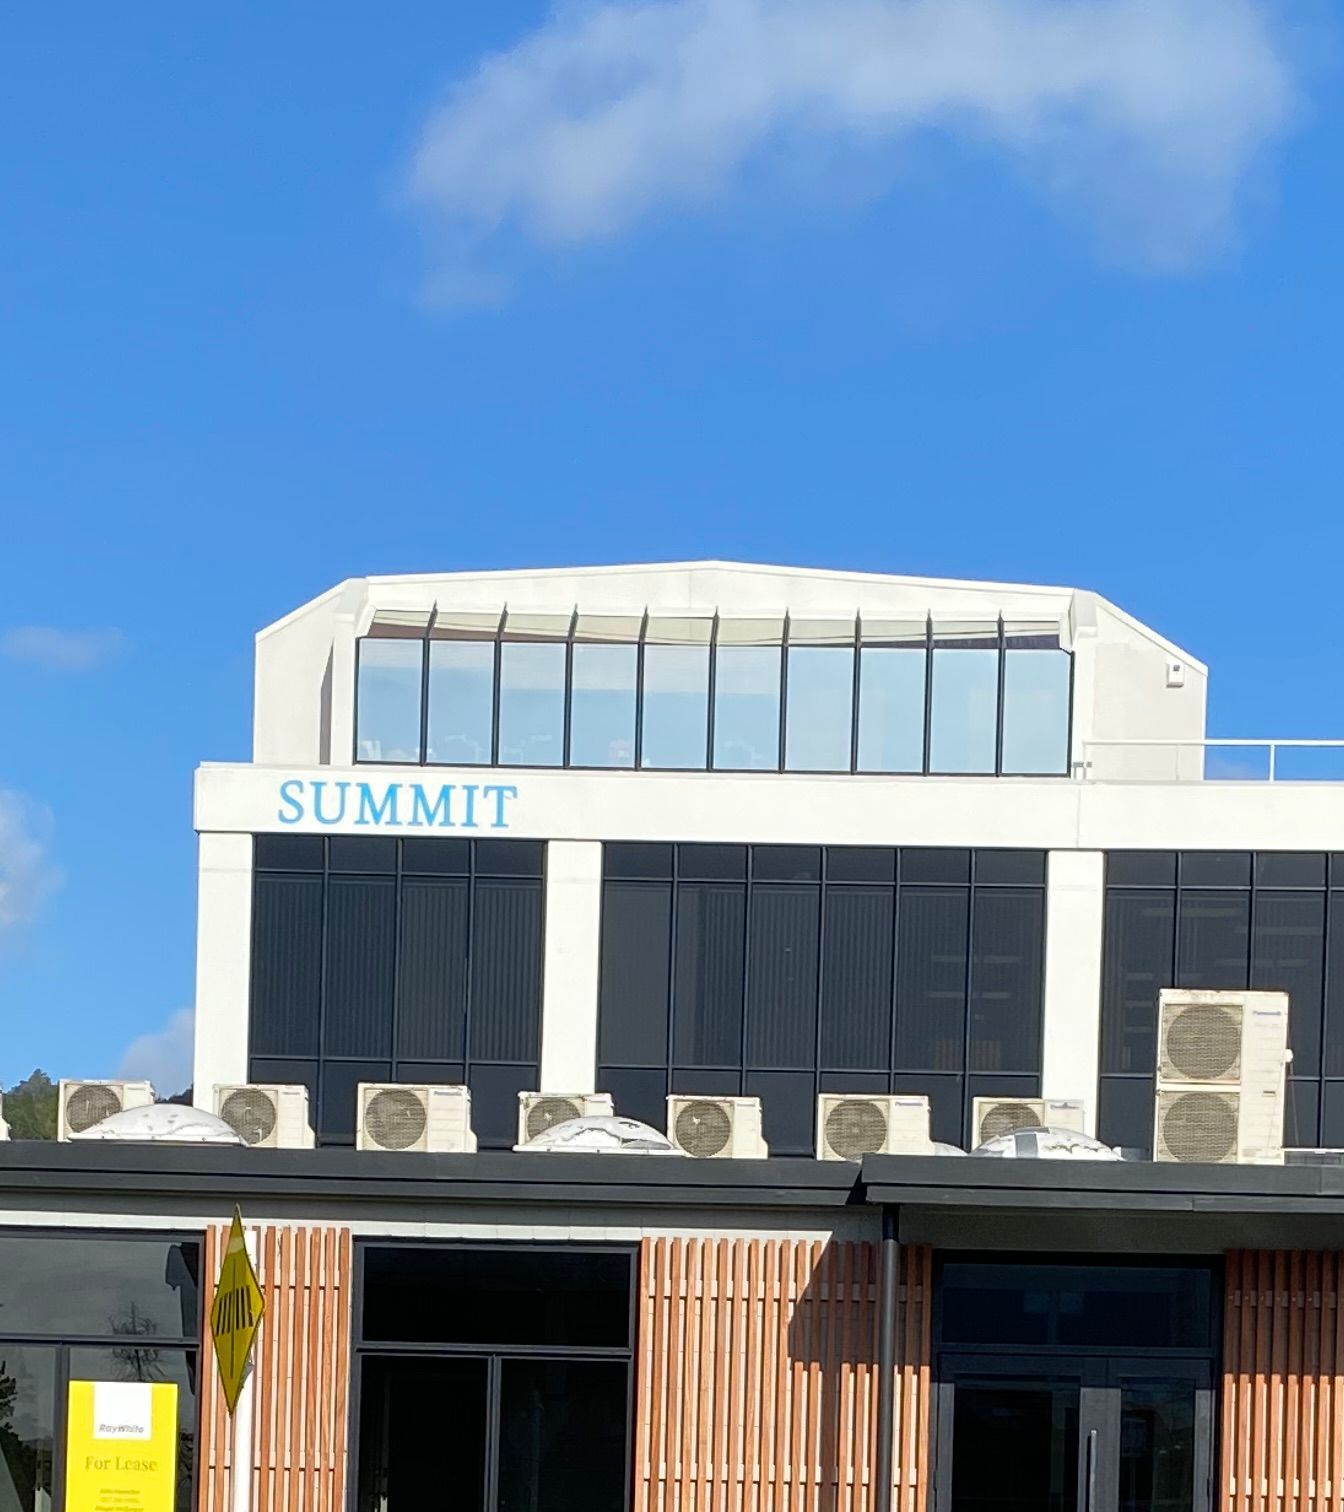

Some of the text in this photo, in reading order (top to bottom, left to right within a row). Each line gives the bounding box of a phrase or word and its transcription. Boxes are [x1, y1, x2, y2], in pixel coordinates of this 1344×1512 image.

[277, 778, 519, 829] SUMMIT
[85, 1456, 158, 1473] For Lease
